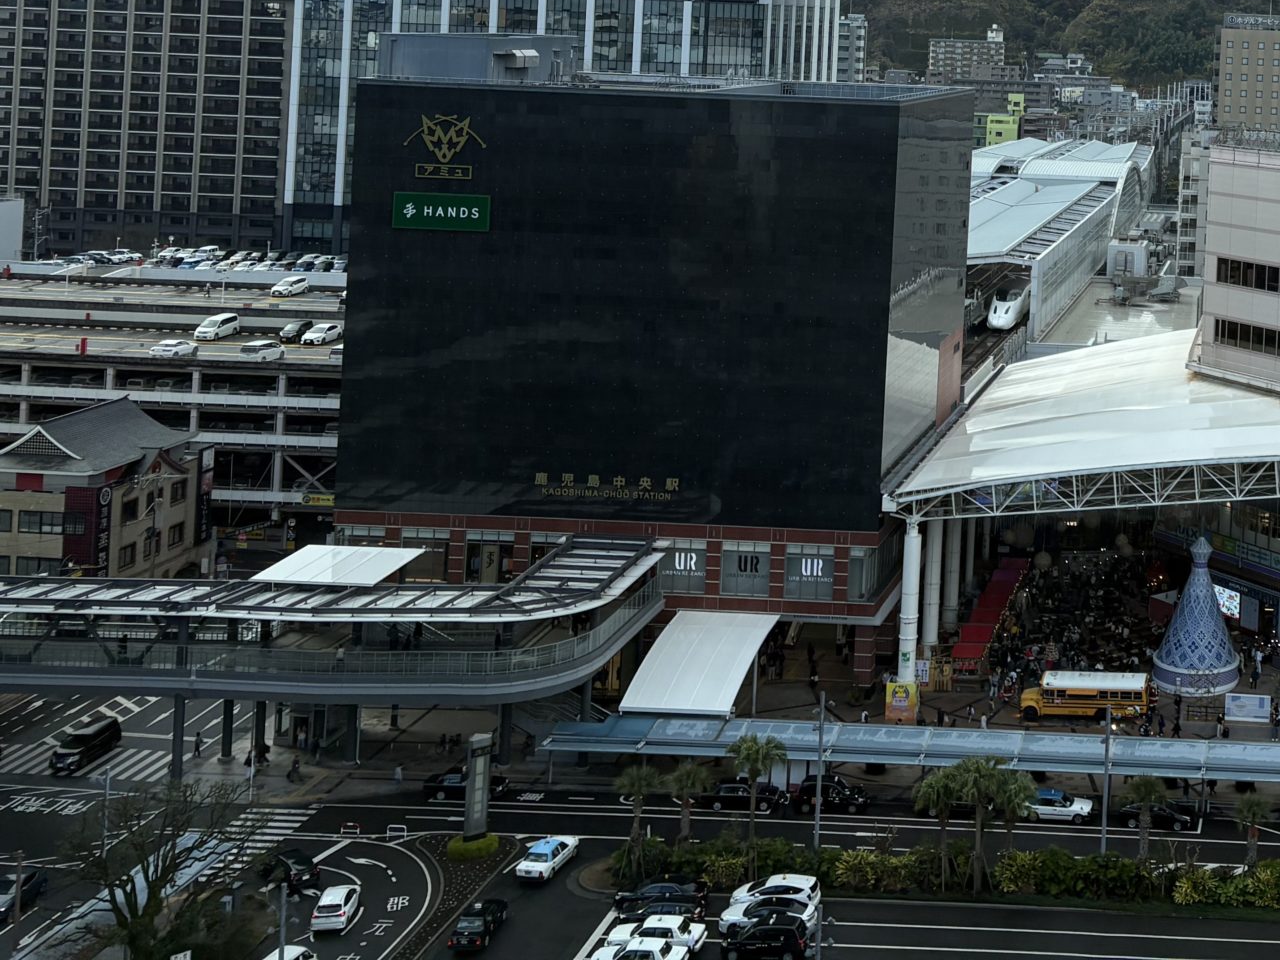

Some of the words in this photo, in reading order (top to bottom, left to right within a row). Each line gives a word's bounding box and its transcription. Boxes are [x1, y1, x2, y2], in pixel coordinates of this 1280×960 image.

[424, 167, 464, 177] アミュ
[423, 206, 480, 219] HANDS
[534, 472, 680, 491] 鹿児島中央駅
[632, 491, 672, 501] STATION
[675, 552, 697, 570] UR
[738, 555, 760, 573] UR
[801, 558, 823, 576] UR
